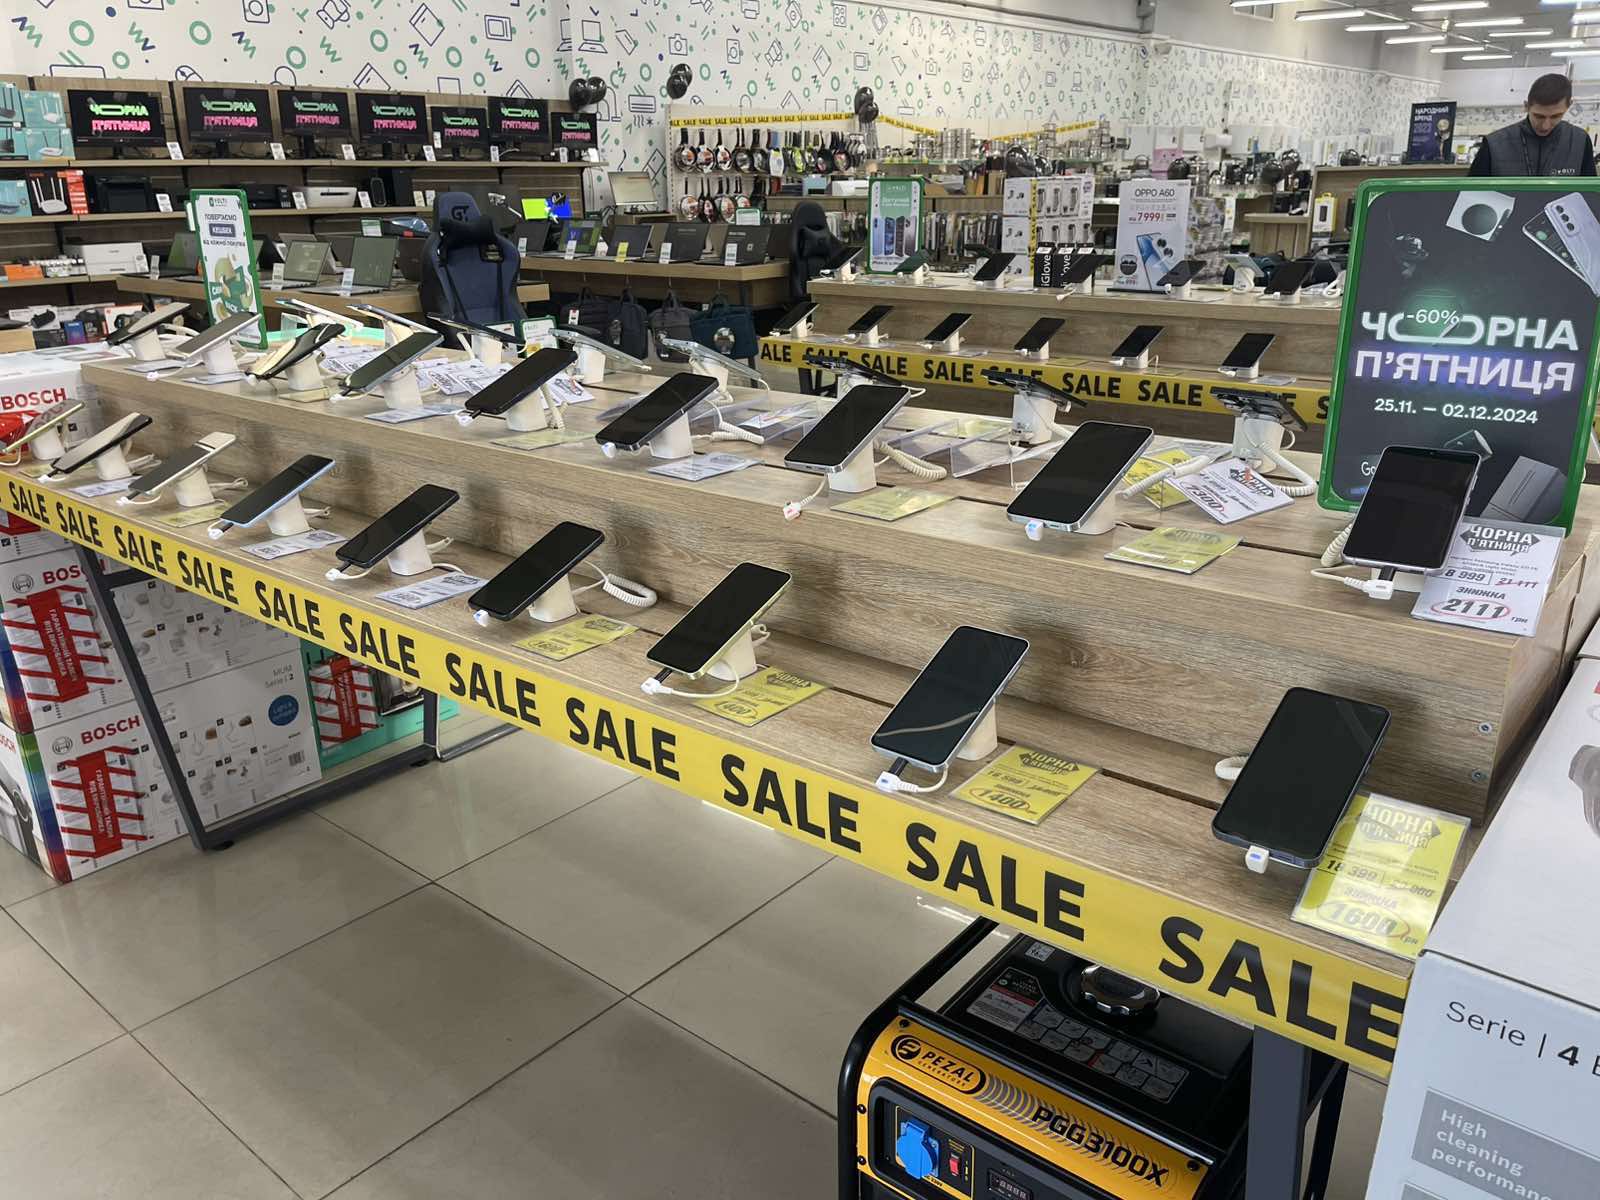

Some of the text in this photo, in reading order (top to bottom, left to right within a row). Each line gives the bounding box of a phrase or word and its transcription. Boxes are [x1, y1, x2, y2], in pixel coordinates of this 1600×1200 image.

[1134, 188, 1175, 198] OPPO A60
[1040, 254, 1052, 287] iGlove
[1361, 311, 1579, 351] ЧОРНА
[1406, 309, 1460, 325] -60%
[861, 353, 907, 376] SALE
[923, 360, 974, 383] SALE
[1062, 373, 1122, 398] SALE
[1137, 380, 1203, 406] SALE
[1355, 350, 1576, 395] П'ЯТНИЦЯ
[1, 388, 67, 410] BOSCH
[1374, 399, 1417, 414] 25.11.
[1442, 404, 1538, 424] 02.12.2024
[1466, 537, 1530, 553] П'ЯТНИЦЯ
[1470, 525, 1532, 545] ЧОРНА
[1458, 571, 1486, 582] 999
[1442, 598, 1505, 618] 2111
[1456, 586, 1506, 600] ЗНИЖКА
[81, 715, 140, 744] BOSCH
[9, 481, 49, 524] SALE
[56, 502, 103, 548] SALE
[114, 525, 167, 576] SALE
[178, 551, 238, 605] SALE
[255, 580, 325, 640] SALE
[339, 613, 420, 679] SALE
[445, 652, 541, 727] SALE
[566, 697, 679, 781] SALE
[721, 753, 862, 853] SALE
[905, 822, 1085, 942] SALE
[1158, 916, 1405, 1063] SALE
[1328, 903, 1397, 936] 1600
[1446, 1001, 1526, 1047] Serie
[1557, 1045, 1580, 1067] 4
[921, 1051, 974, 1082] PEZAL
[1440, 1109, 1487, 1139] High
[1031, 1104, 1170, 1186] PGG3100X
[1436, 1130, 1523, 1177] cleaning
